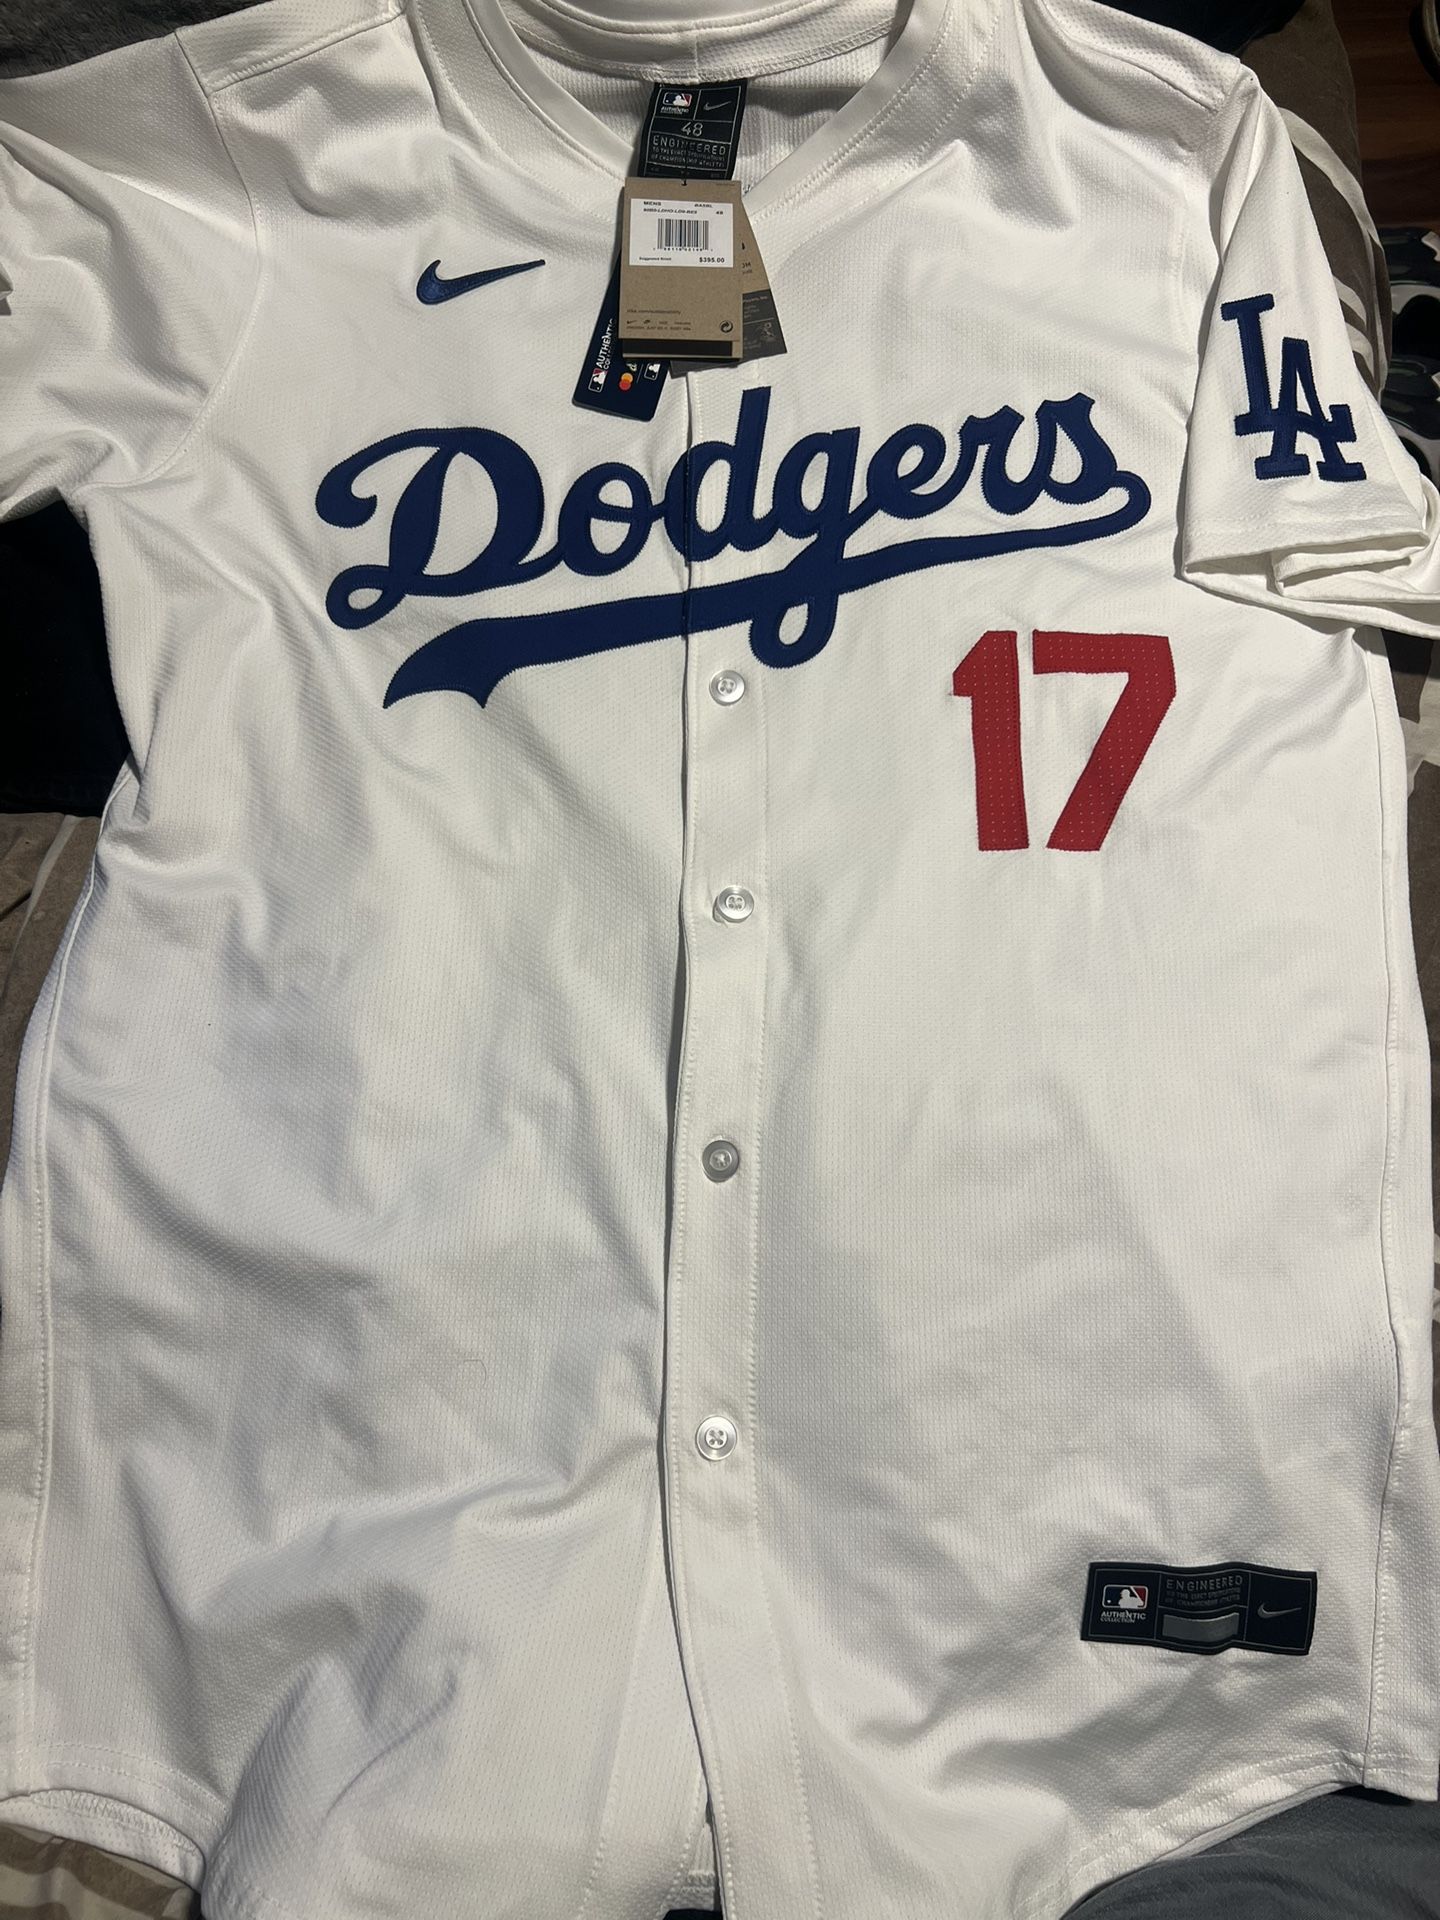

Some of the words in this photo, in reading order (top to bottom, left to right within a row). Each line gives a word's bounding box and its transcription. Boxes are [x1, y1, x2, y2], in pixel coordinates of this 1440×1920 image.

[681, 121, 703, 137] 48
[652, 134, 726, 155] ENGINEERED
[1221, 293, 1367, 483] LA
[316, 386, 1151, 669] Dodgers
[952, 629, 1177, 852] 17
[1166, 1575, 1243, 1592] ENGINEERED
[1101, 1610, 1147, 1621] AUTHENTIC
